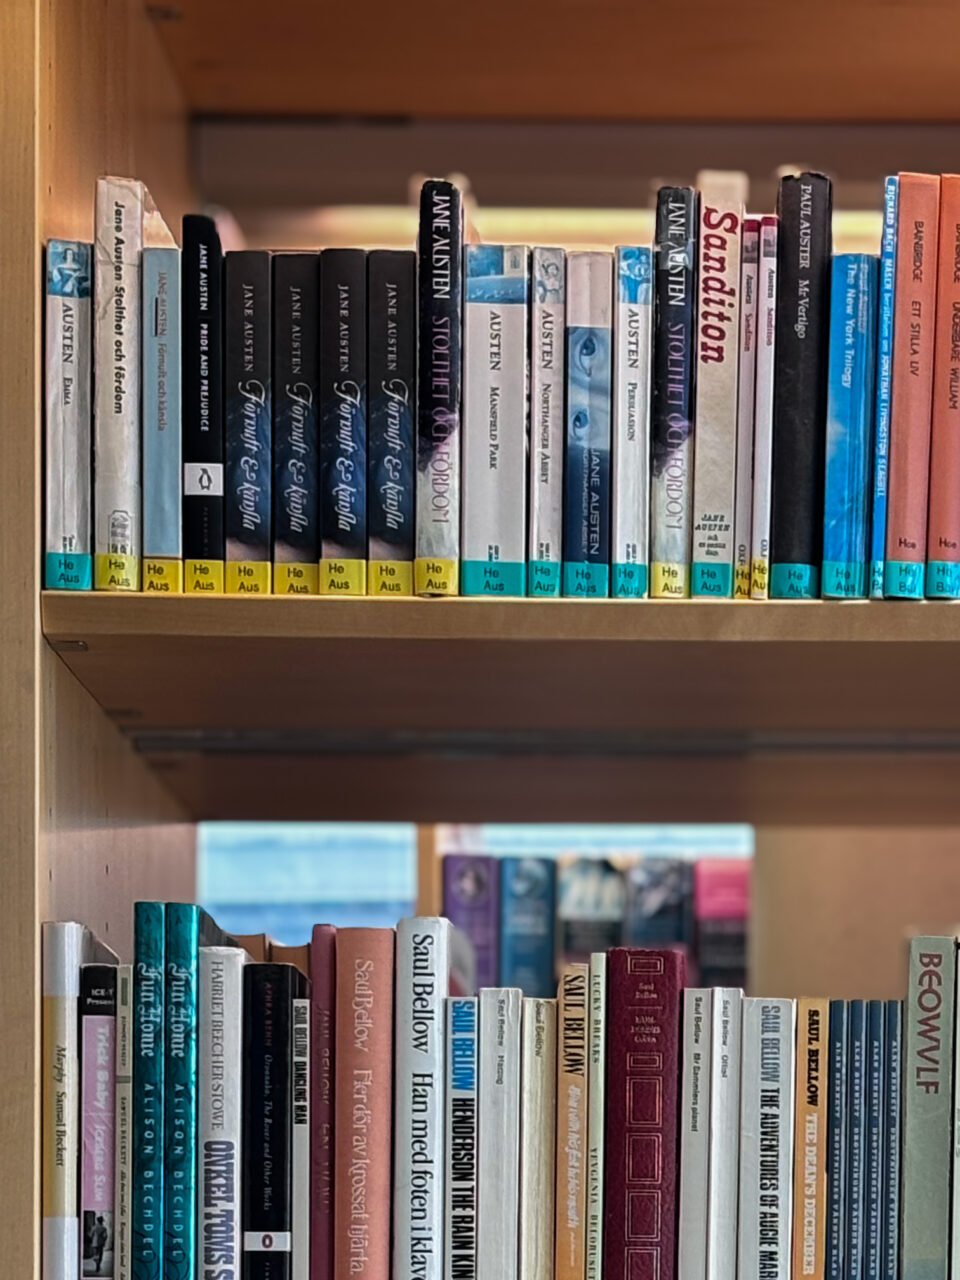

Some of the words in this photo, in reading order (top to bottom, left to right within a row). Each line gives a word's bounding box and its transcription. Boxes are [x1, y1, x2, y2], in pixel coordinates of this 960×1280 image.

[114, 201, 125, 233] Jane
[433, 190, 451, 233] JANE
[800, 185, 811, 218] PAUL
[114, 236, 125, 281] Austen
[199, 244, 209, 270] JANE
[799, 220, 811, 268] AUSTER
[432, 234, 451, 298] AUSTEN
[702, 207, 738, 363] Sanditon
[846, 264, 856, 285] The
[199, 273, 209, 311] AUSTEN
[338, 285, 349, 316] JANE
[798, 280, 809, 297] Mr
[845, 289, 856, 315] New
[114, 285, 125, 336] Stolthet
[794, 299, 809, 338] Vertigo
[62, 303, 73, 364] AUSTEN
[114, 339, 125, 363] och
[200, 324, 209, 351] PRIDE
[339, 322, 349, 372] AUSTEN
[490, 311, 501, 371] AUSTEN
[845, 318, 855, 345] York
[200, 354, 209, 377] AND
[841, 349, 853, 388] Trilogy
[114, 366, 126, 414] fördom
[200, 380, 209, 431] PREJUDICE
[949, 368, 959, 409] WILLIAM
[381, 565, 397, 576] He
[381, 582, 401, 591] Aus
[412, 934, 432, 978] Saul
[168, 964, 189, 1003] Fun
[168, 1006, 188, 1057] Home
[411, 983, 431, 1053] Bellow
[452, 1000, 475, 1034] SAUL
[761, 1006, 780, 1034] SAUL
[54, 1045, 66, 1083] Murphy
[452, 1038, 475, 1090] BELLOW
[761, 1038, 780, 1082] BELLOW
[55, 1092, 66, 1126] Samuel
[412, 1072, 432, 1113] Han
[760, 1088, 780, 1109] THE
[173, 1083, 184, 1154] ALISON
[55, 1129, 66, 1166] Beckett
[411, 1119, 433, 1164] med
[452, 1098, 475, 1182] HENDERSON
[759, 1113, 779, 1191] ADVENTURES
[203, 1140, 235, 1207] ONKEL
[173, 1171, 184, 1257] BECHDEL
[411, 1169, 432, 1220] foten
[452, 1185, 475, 1211] THE
[759, 1194, 779, 1209] OF
[203, 1211, 235, 1266] TOMS
[452, 1215, 475, 1250] RAIN
[759, 1212, 778, 1247] AUGIE
